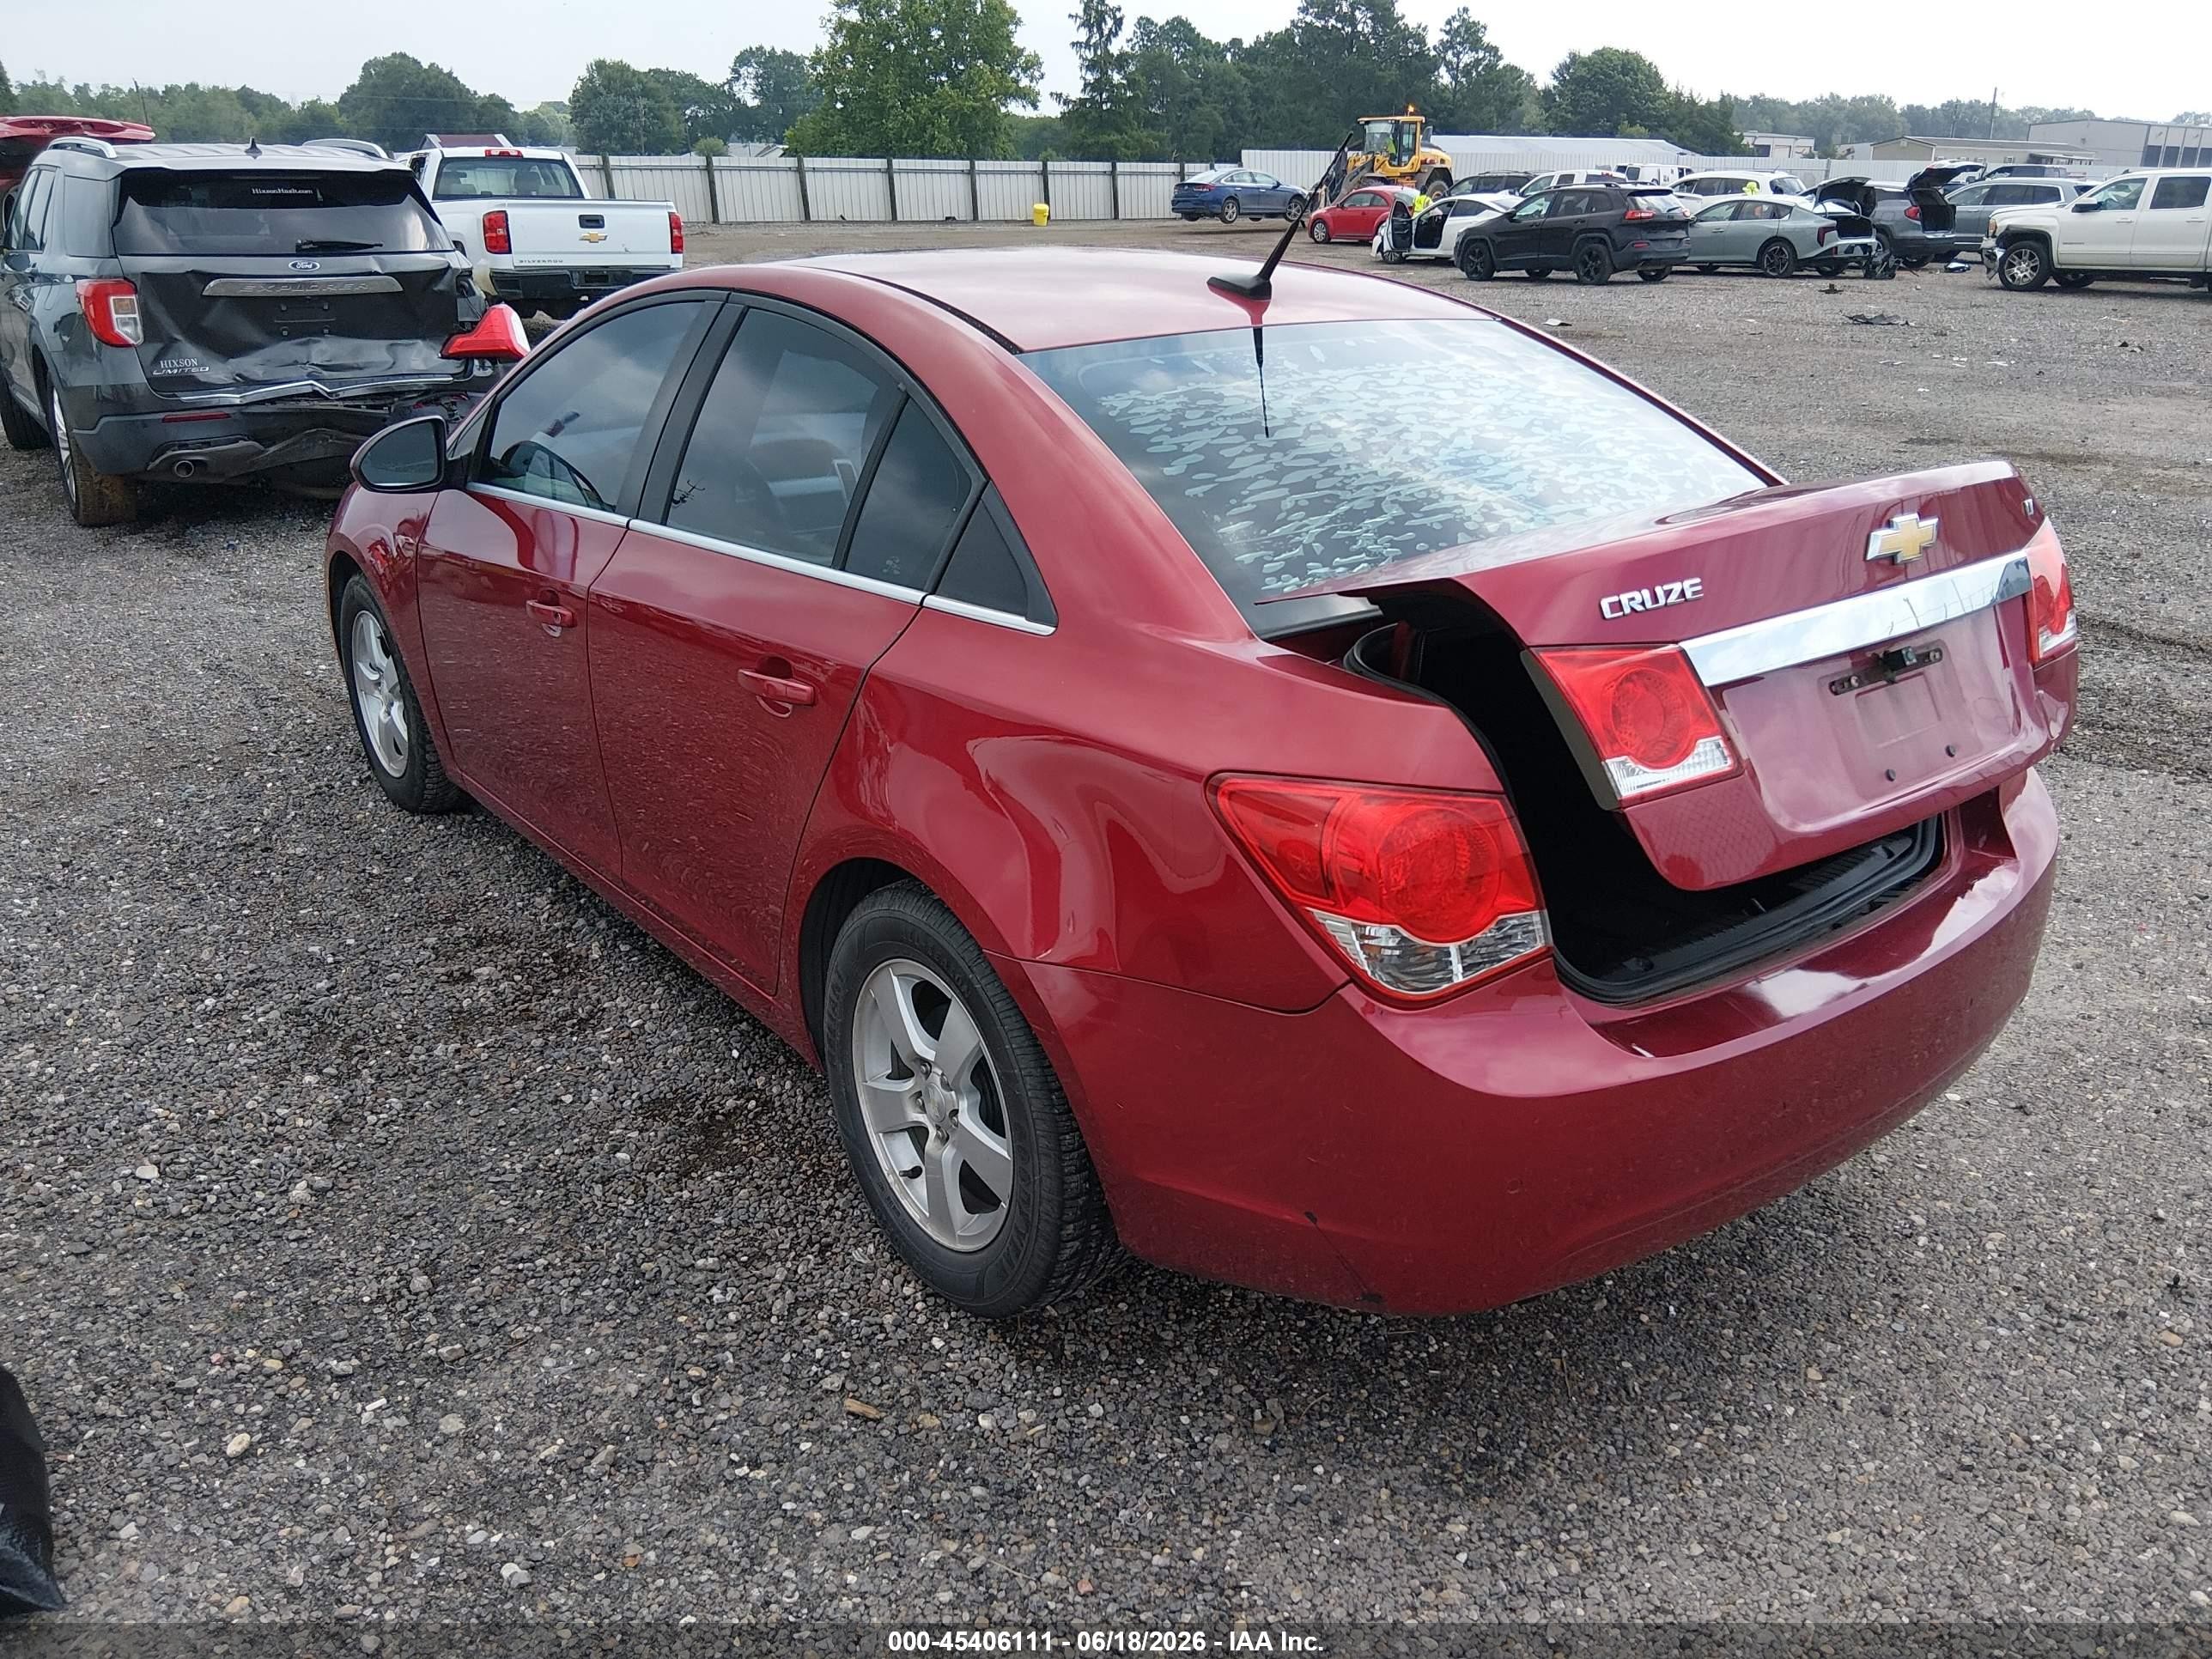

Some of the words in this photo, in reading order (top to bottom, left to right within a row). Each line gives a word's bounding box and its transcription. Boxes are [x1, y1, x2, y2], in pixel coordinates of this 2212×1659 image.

[295, 260, 313, 269] Ford
[240, 283, 369, 293] EXPLORER
[160, 358, 198, 368] HIXSON
[152, 366, 210, 375] LIMITED
[1599, 577, 1705, 620] CRUZE
